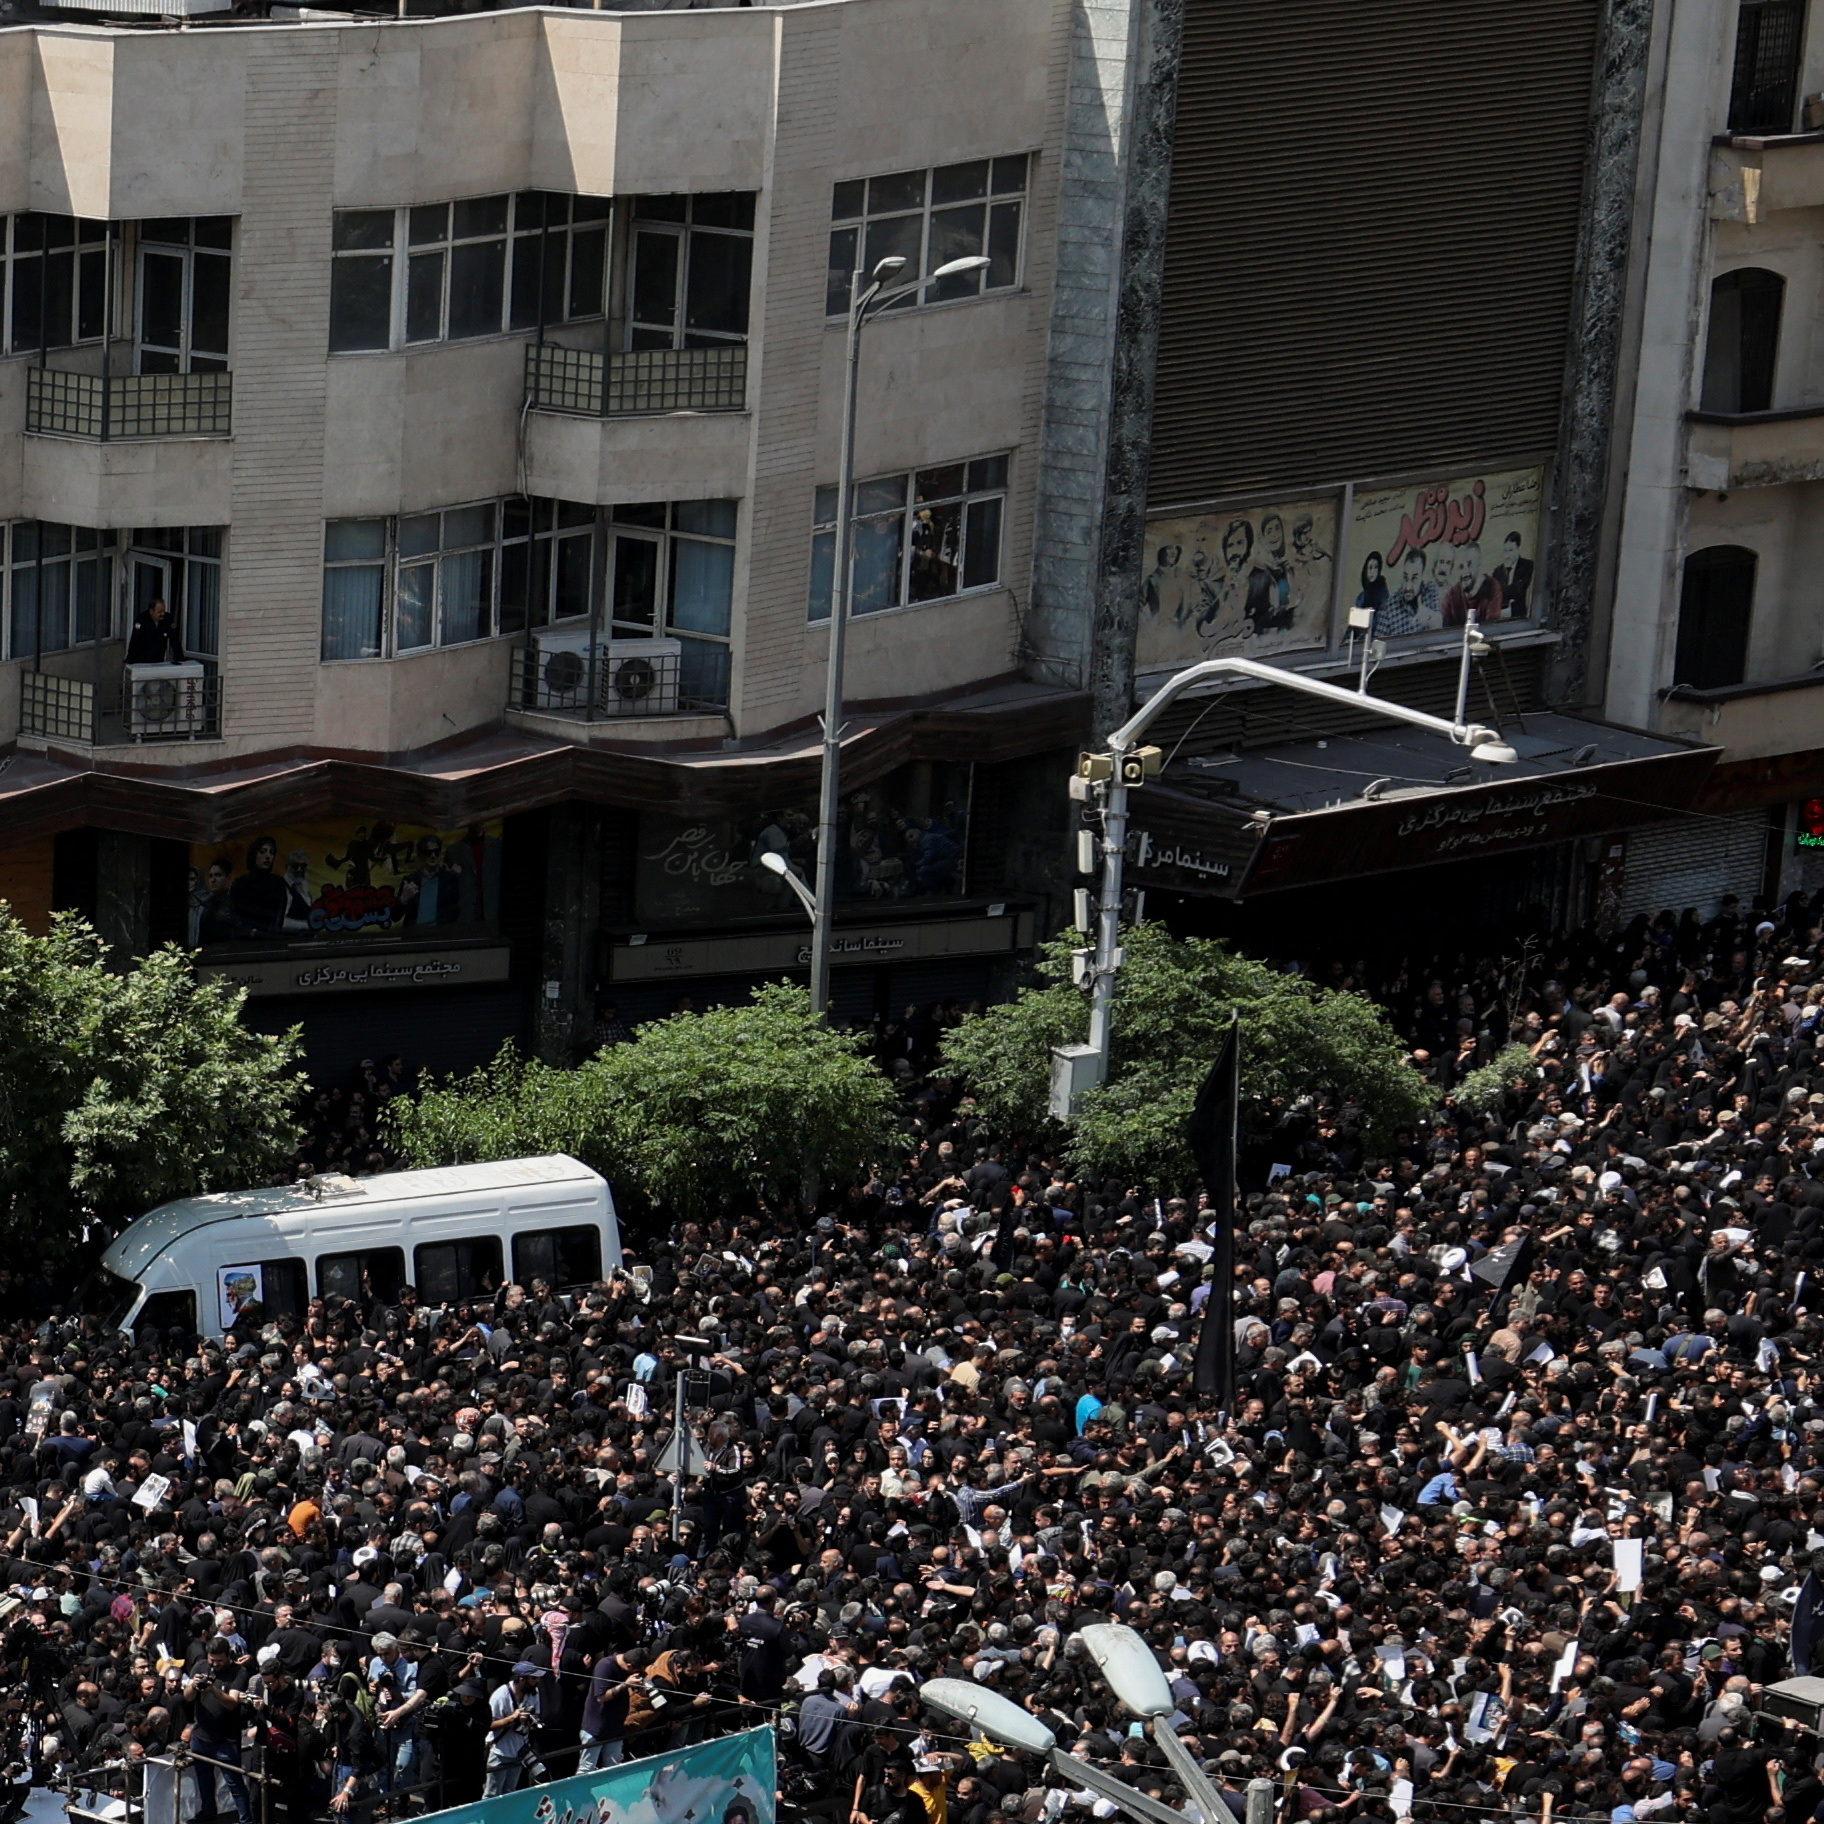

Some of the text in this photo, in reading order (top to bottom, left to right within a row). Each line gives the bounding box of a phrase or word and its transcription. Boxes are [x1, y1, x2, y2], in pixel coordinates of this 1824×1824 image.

[1176, 845, 1230, 879] سینما
[863, 937, 904, 954] سینما
[298, 960, 461, 987] مجتمع سینمایی مرکزی
